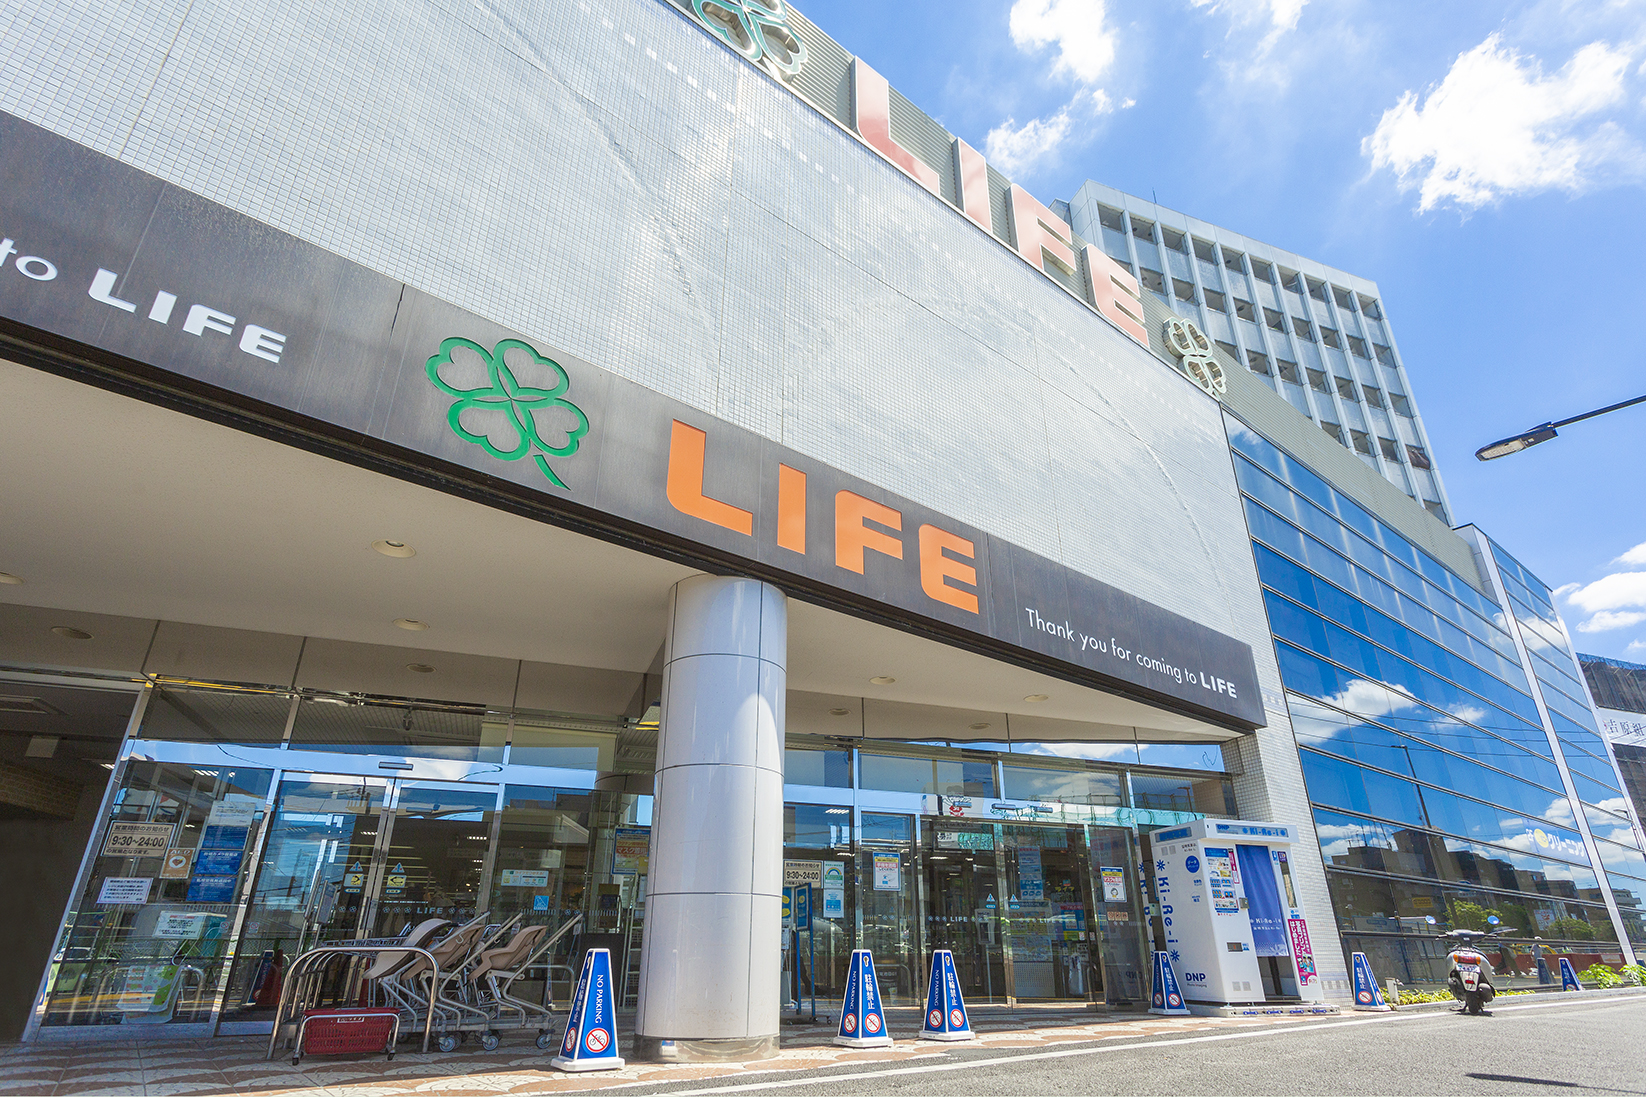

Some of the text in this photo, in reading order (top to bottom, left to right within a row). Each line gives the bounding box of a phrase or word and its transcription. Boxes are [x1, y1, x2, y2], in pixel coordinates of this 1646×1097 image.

[850, 55, 1150, 351] LIFE
[88, 268, 287, 363] LIFE
[666, 418, 979, 615] LIFE
[1025, 607, 1237, 699] Thank you for coming to LIFE
[1547, 833, 1586, 857] クリーニング
[1158, 877, 1178, 943] Ki-Re-i
[594, 974, 604, 1024] NO PARKING
[864, 973, 875, 1010] 駐輪禁止
[1185, 972, 1206, 982] DNP
